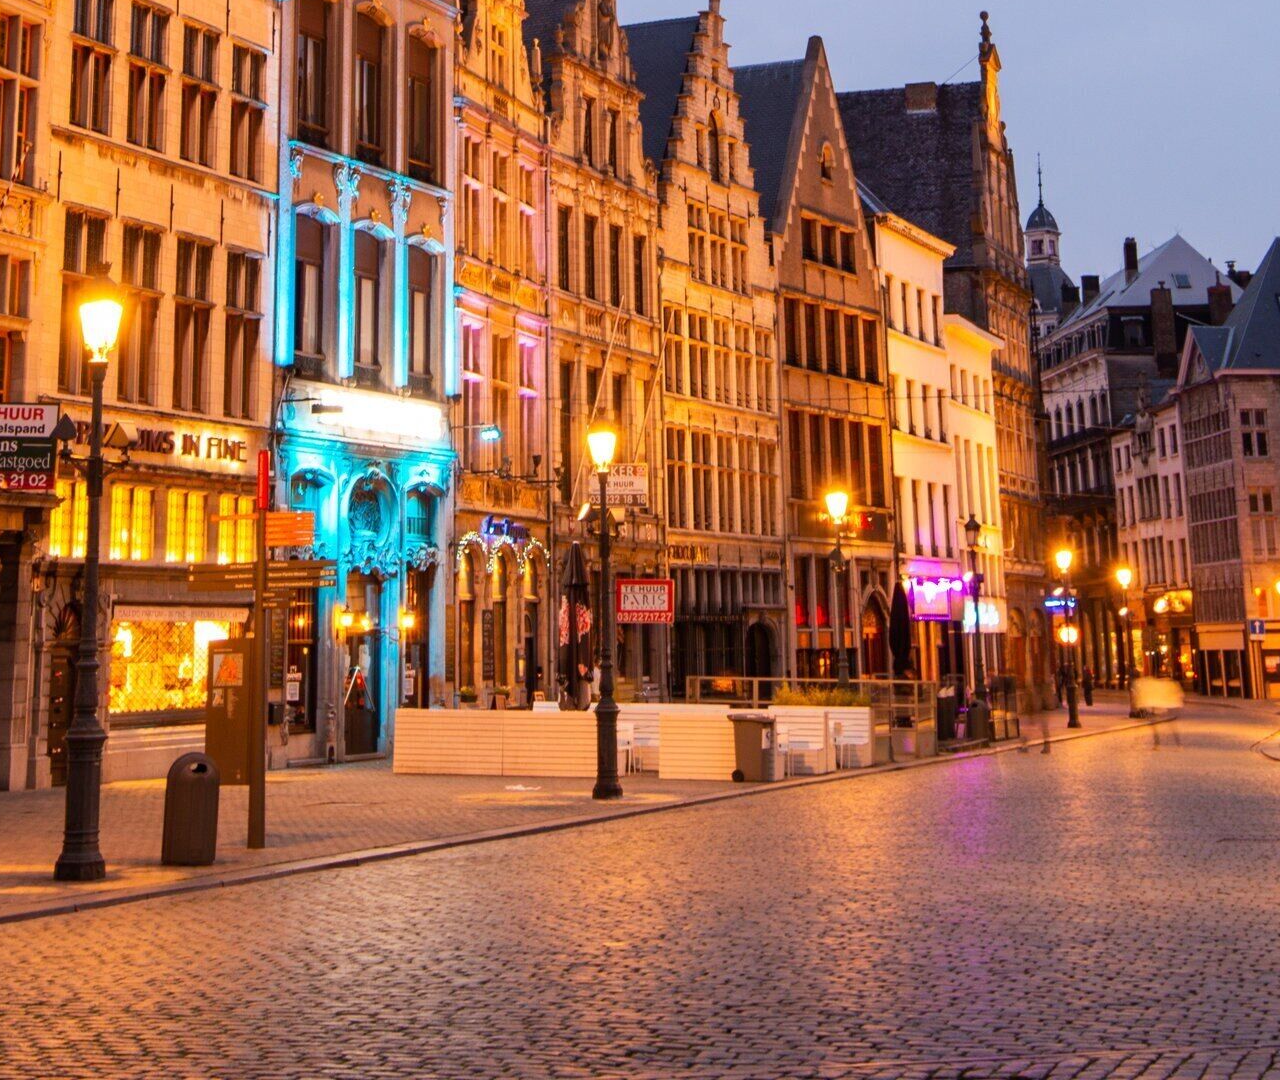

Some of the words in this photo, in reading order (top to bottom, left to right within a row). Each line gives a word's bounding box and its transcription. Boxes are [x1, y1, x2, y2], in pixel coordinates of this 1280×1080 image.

[182, 433, 200, 457] IN
[207, 437, 248, 463] FINE
[590, 465, 634, 477] AKER
[10, 474, 25, 487] 21
[29, 476, 47, 487] 02
[623, 494, 632, 504] 18
[636, 494, 646, 504] 18
[624, 585, 635, 593] TE
[639, 585, 666, 593] HUUR
[623, 594, 666, 606] PARIS
